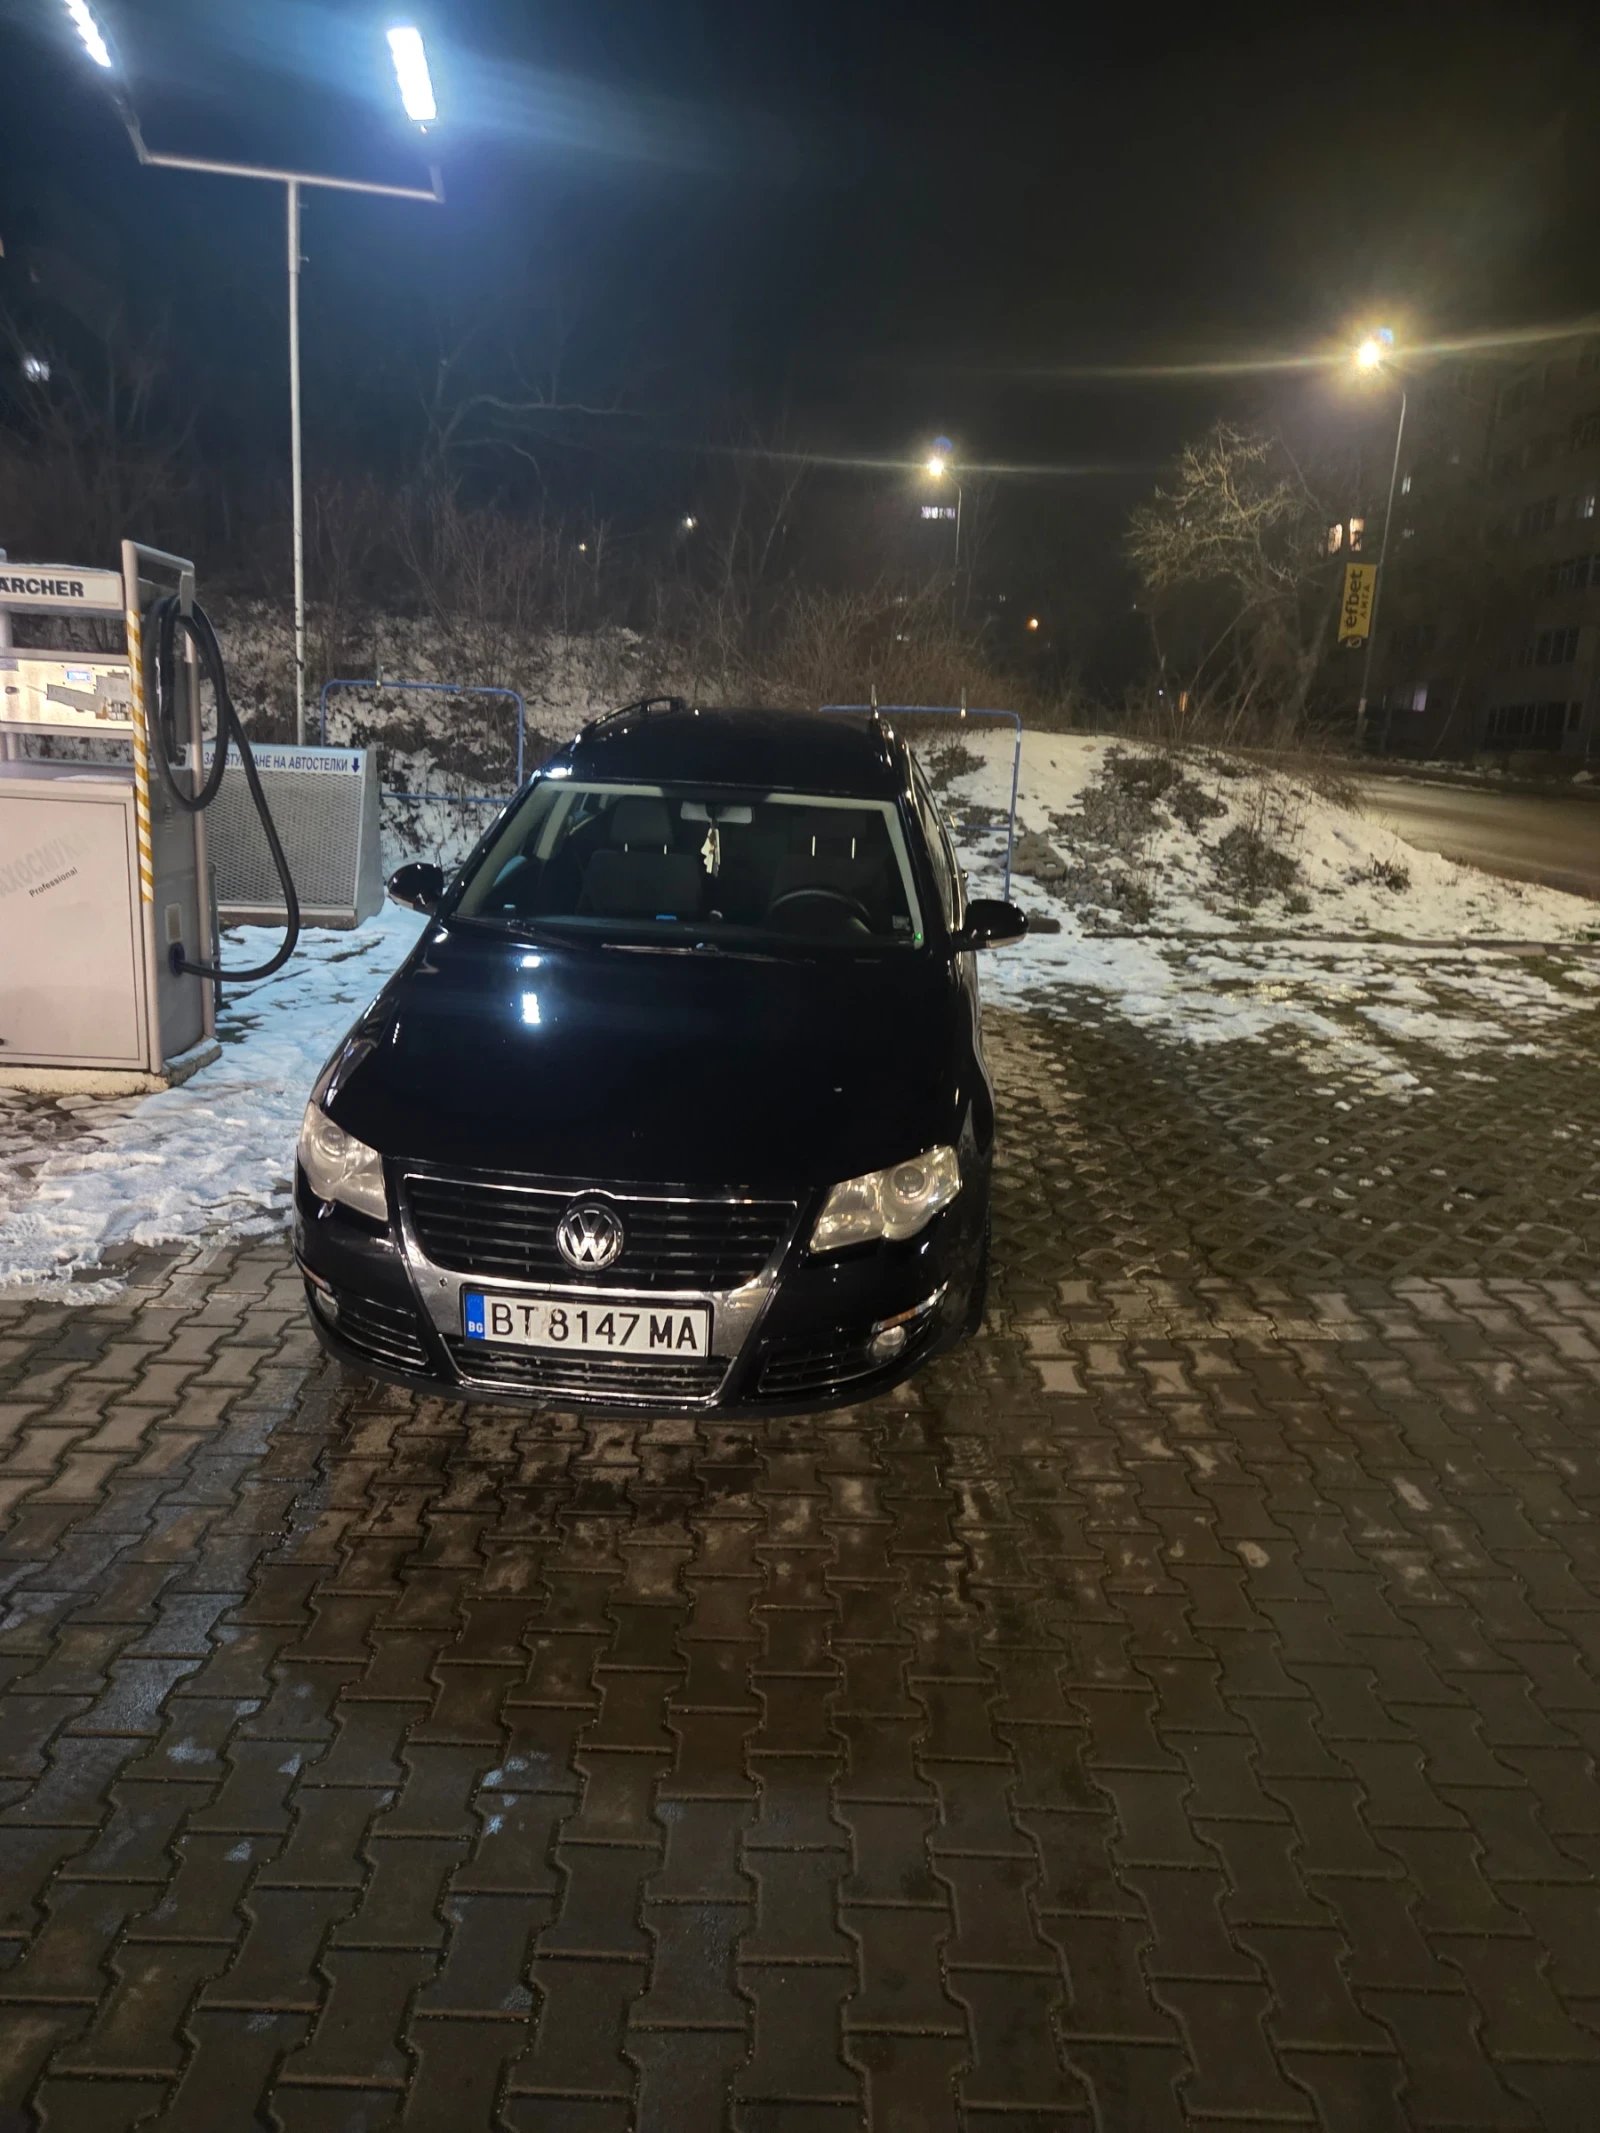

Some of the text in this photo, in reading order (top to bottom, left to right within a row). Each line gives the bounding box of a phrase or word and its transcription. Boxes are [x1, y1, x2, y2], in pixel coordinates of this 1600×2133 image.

[1344, 569, 1363, 629] efbet
[274, 757, 287, 769] НА
[288, 757, 348, 772] АВТОСТЕЛКИ
[28, 866, 79, 897] Professional
[468, 1320, 484, 1334] BG
[491, 1303, 698, 1350] BT 8147 MA
